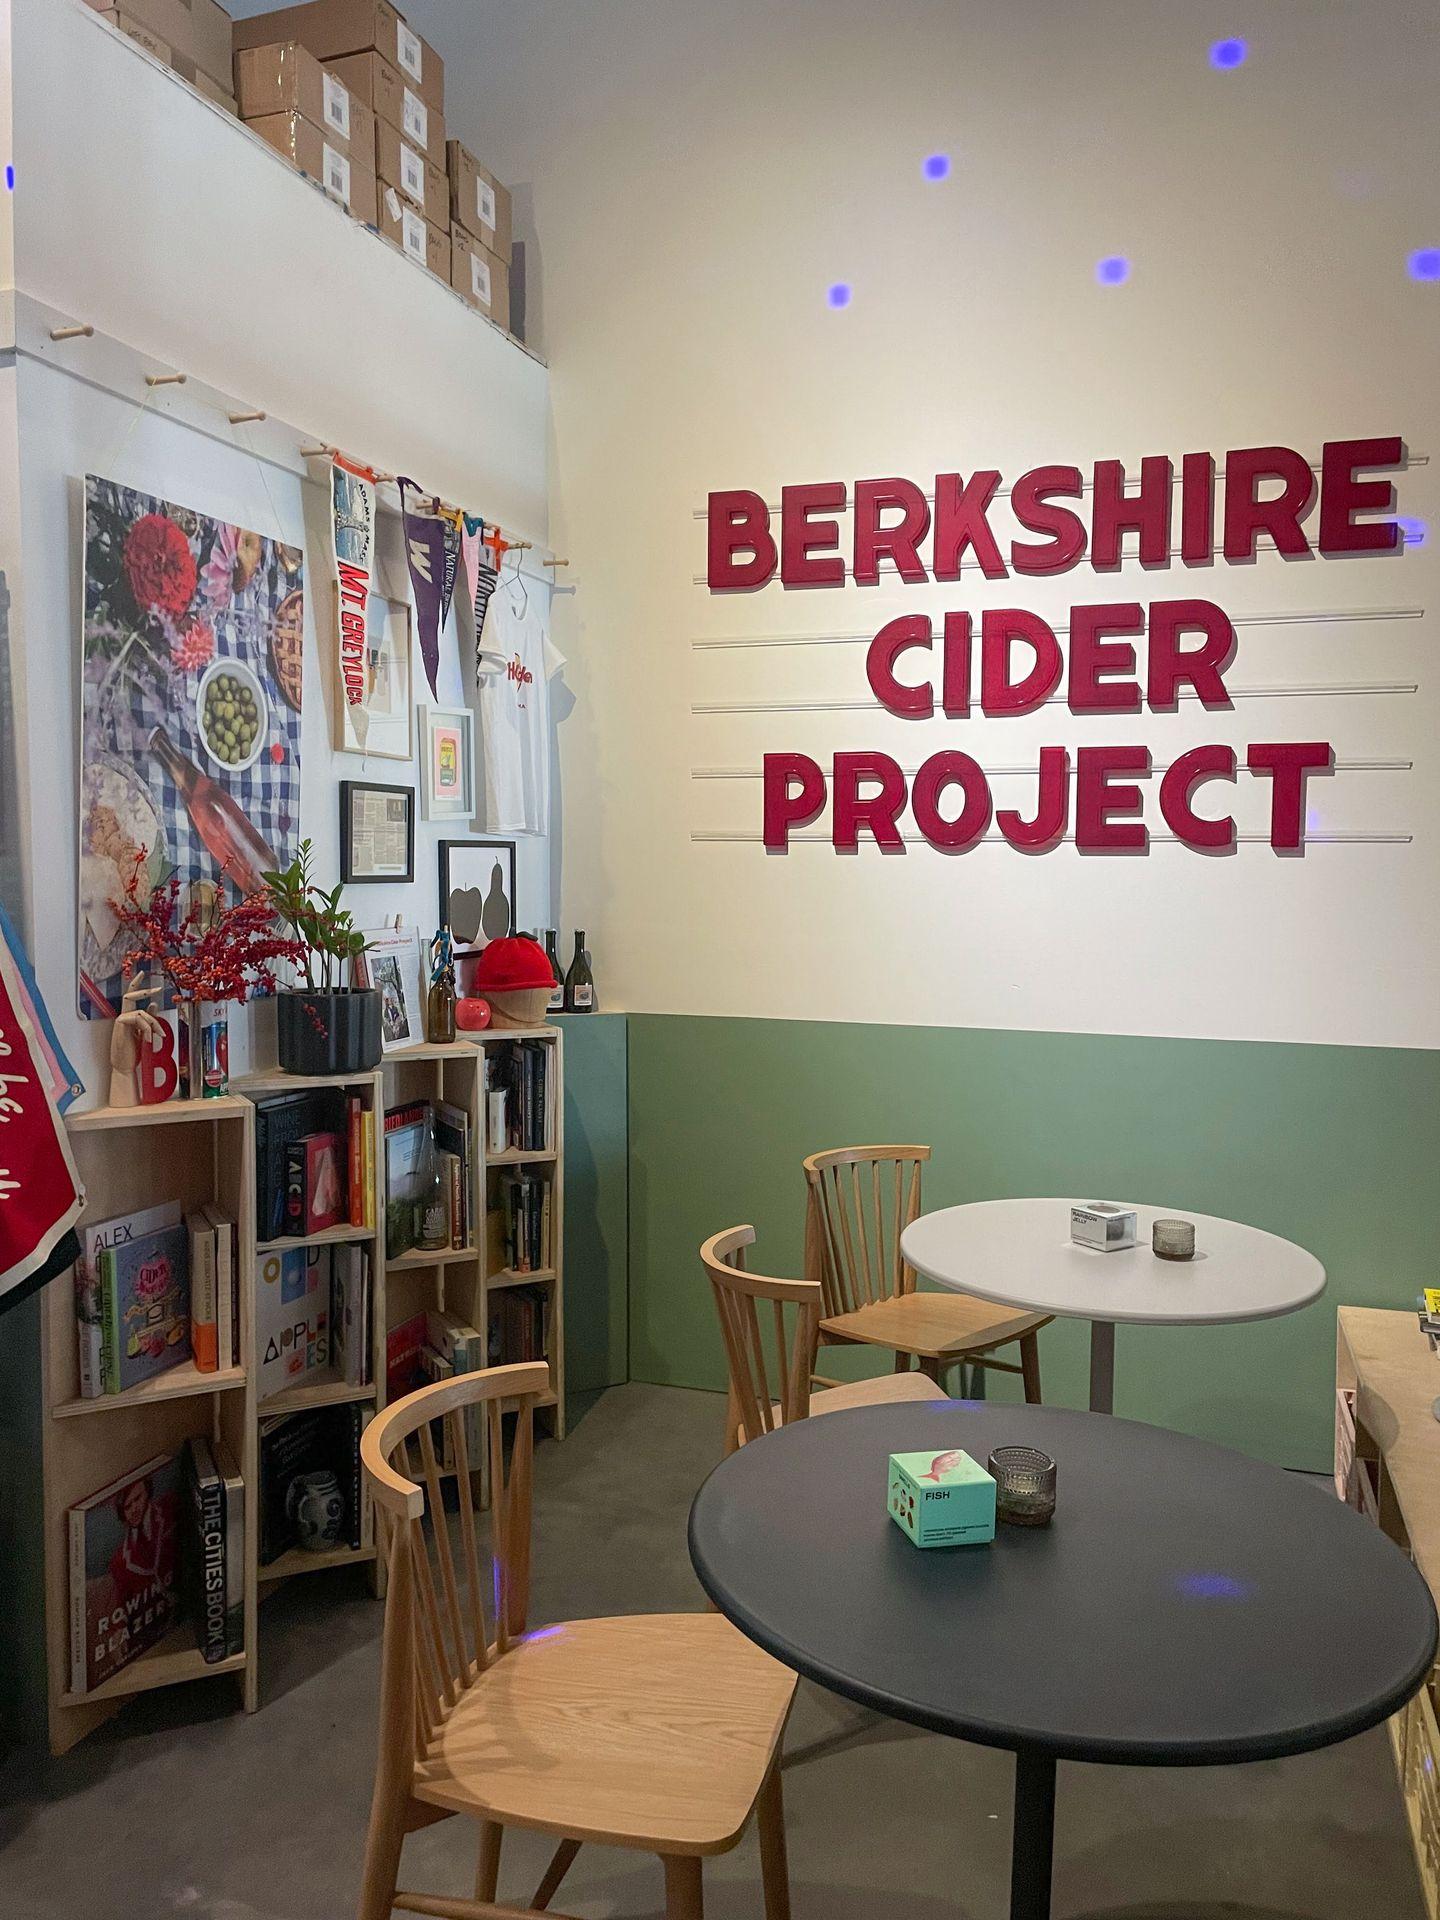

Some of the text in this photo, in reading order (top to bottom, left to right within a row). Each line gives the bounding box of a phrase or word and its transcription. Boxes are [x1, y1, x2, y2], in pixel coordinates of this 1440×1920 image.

[358, 483, 370, 523] ADAMS
[708, 437, 1402, 589] BERKSHIRE
[444, 551, 456, 591] NATURAL
[337, 560, 370, 706] MT. GREYLOCK
[867, 599, 1235, 718] CIDER
[763, 742, 1329, 855] PROJECT
[93, 1223, 135, 1253] ALEX
[925, 1491, 950, 1501] FISH
[202, 1488, 226, 1646] THE CITIES BOOK
